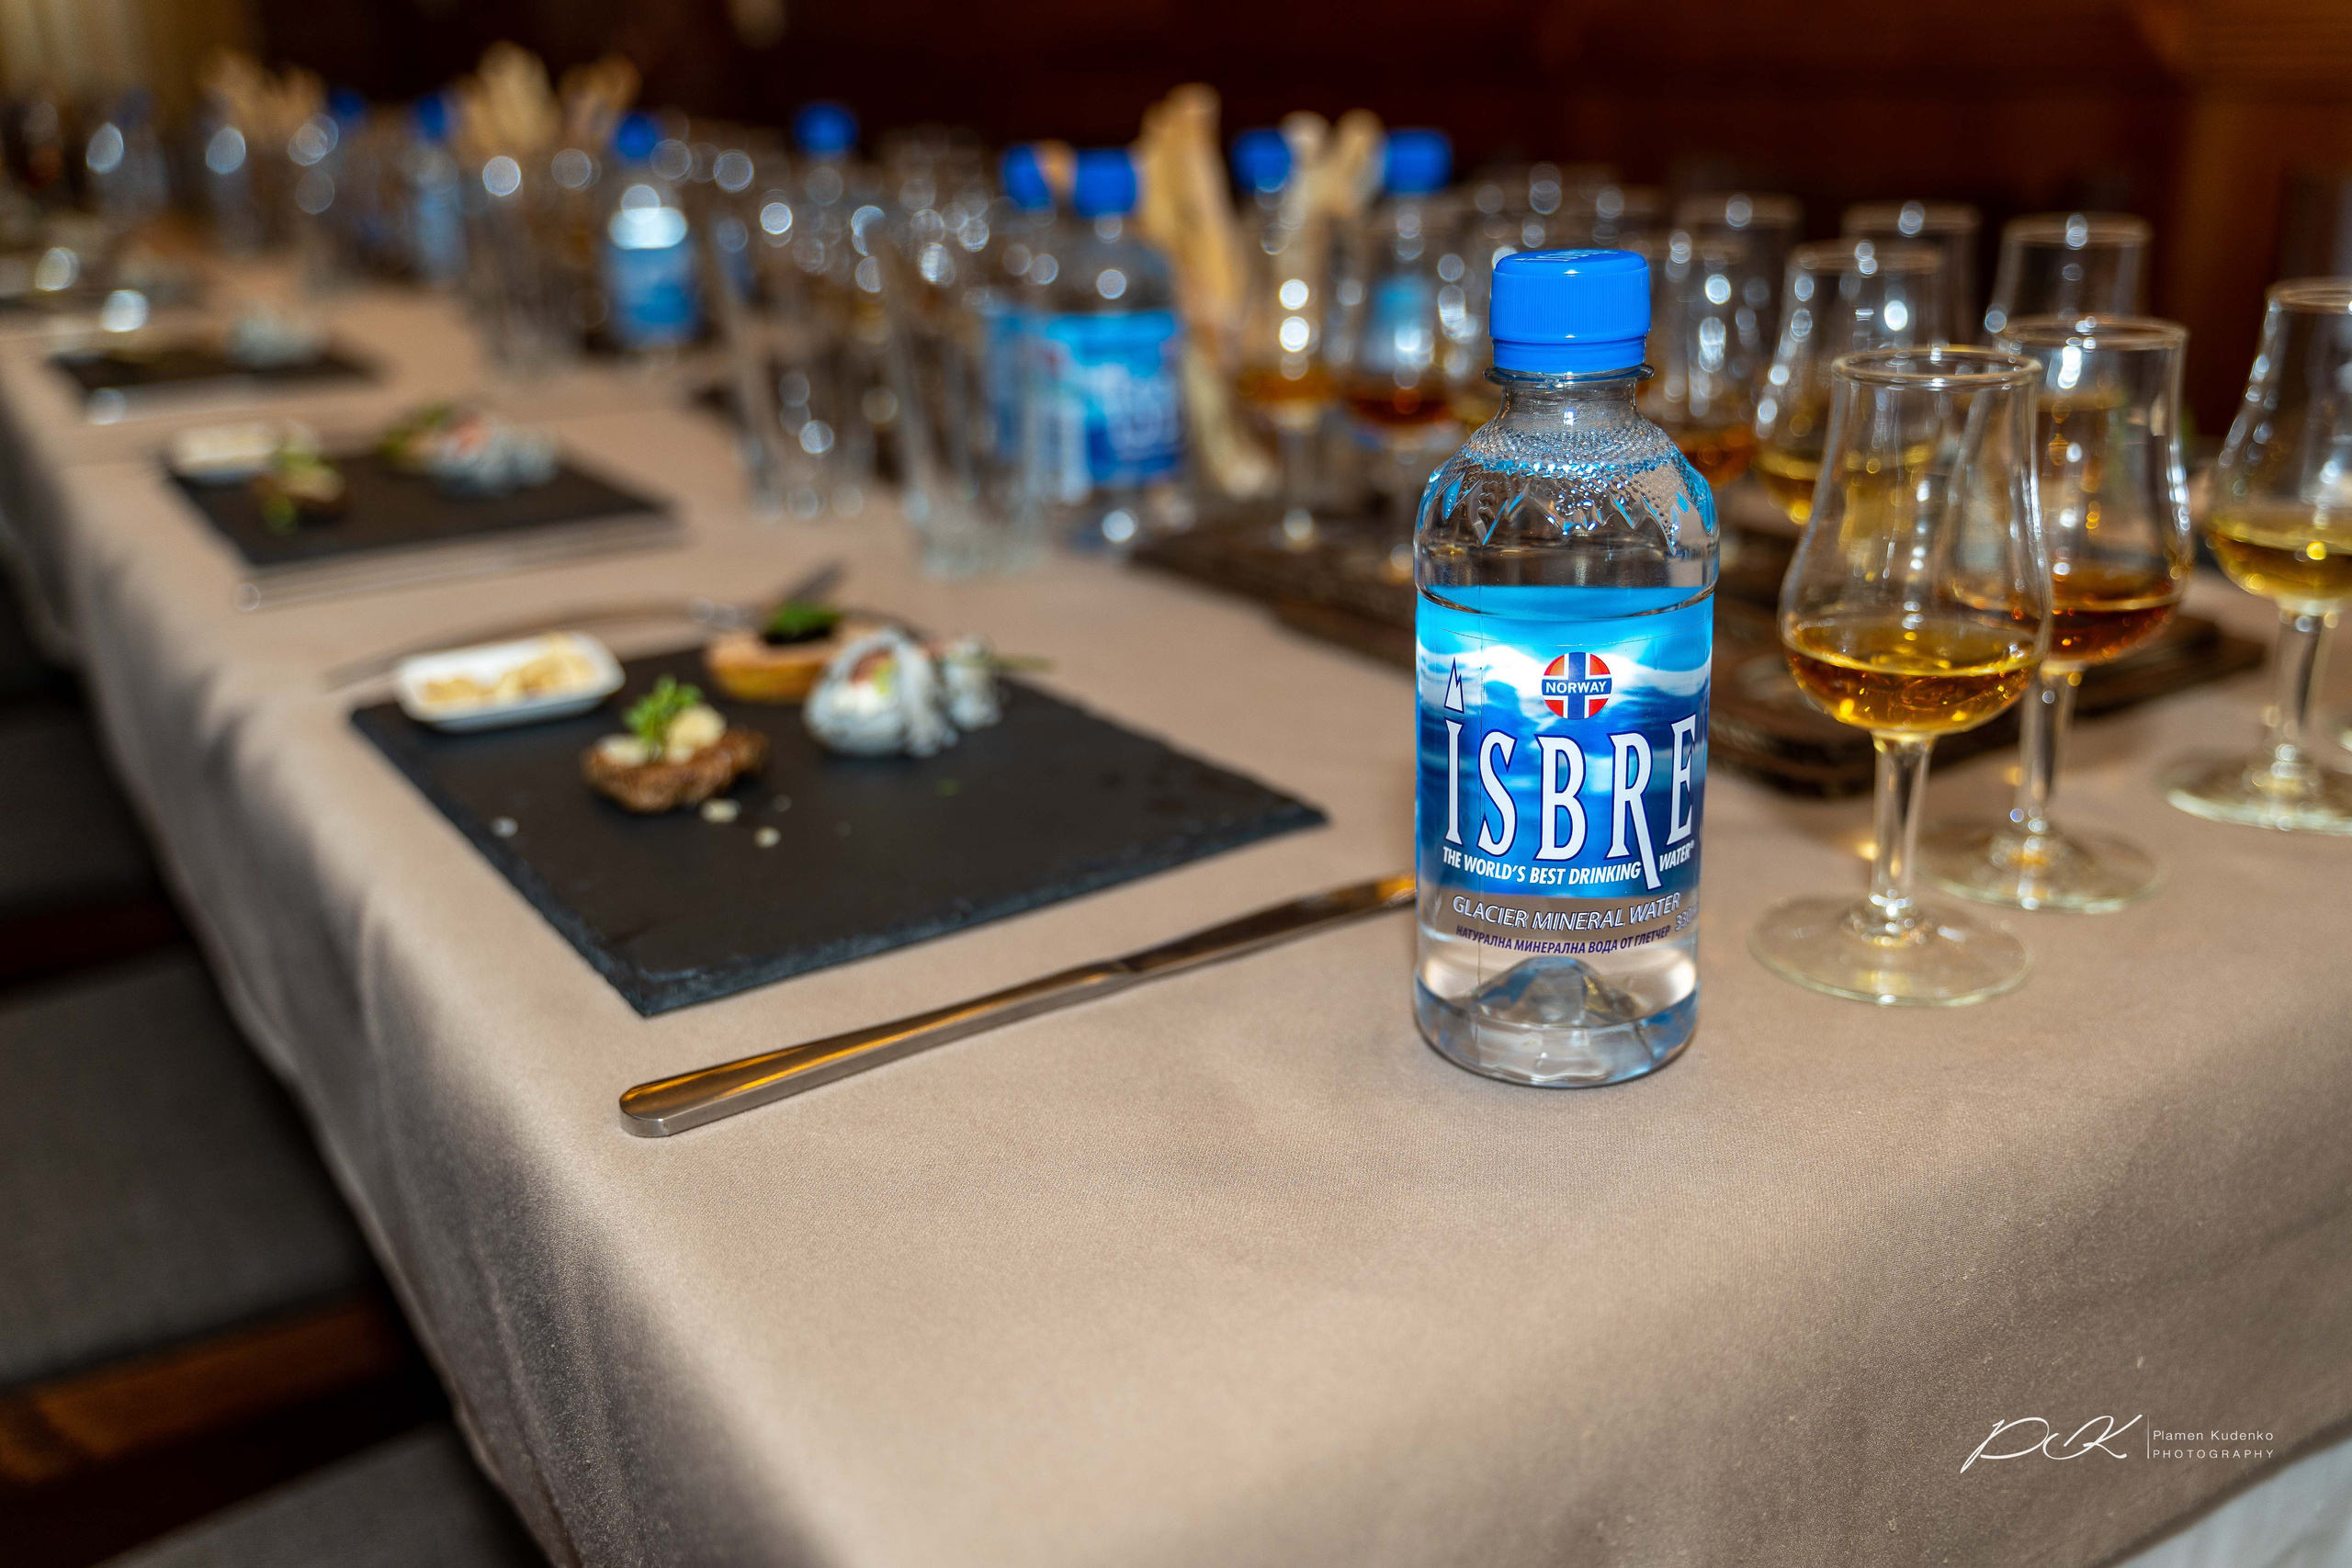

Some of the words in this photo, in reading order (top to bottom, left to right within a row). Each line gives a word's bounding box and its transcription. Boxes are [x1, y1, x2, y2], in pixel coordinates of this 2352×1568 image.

[1545, 681, 1607, 694] NORWAY
[1443, 709, 1697, 891] ISBRE
[1442, 846, 1462, 869] THE
[1464, 854, 1526, 883] WORLD'S
[1530, 867, 1566, 886] BEST
[1568, 861, 1642, 886] DRINKING
[1453, 895, 1530, 930] GLACIER
[1532, 908, 1625, 931] MINERAL
[1629, 891, 1681, 925] WATER
[1456, 924, 1512, 950] НАТУРАЛНА
[1514, 939, 1586, 954] МИНЕРАЛНА
[1588, 940, 1618, 954] ВОДА
[1620, 936, 1634, 950] ОТ
[1634, 924, 1670, 947] ГЛЕТЧЕР
